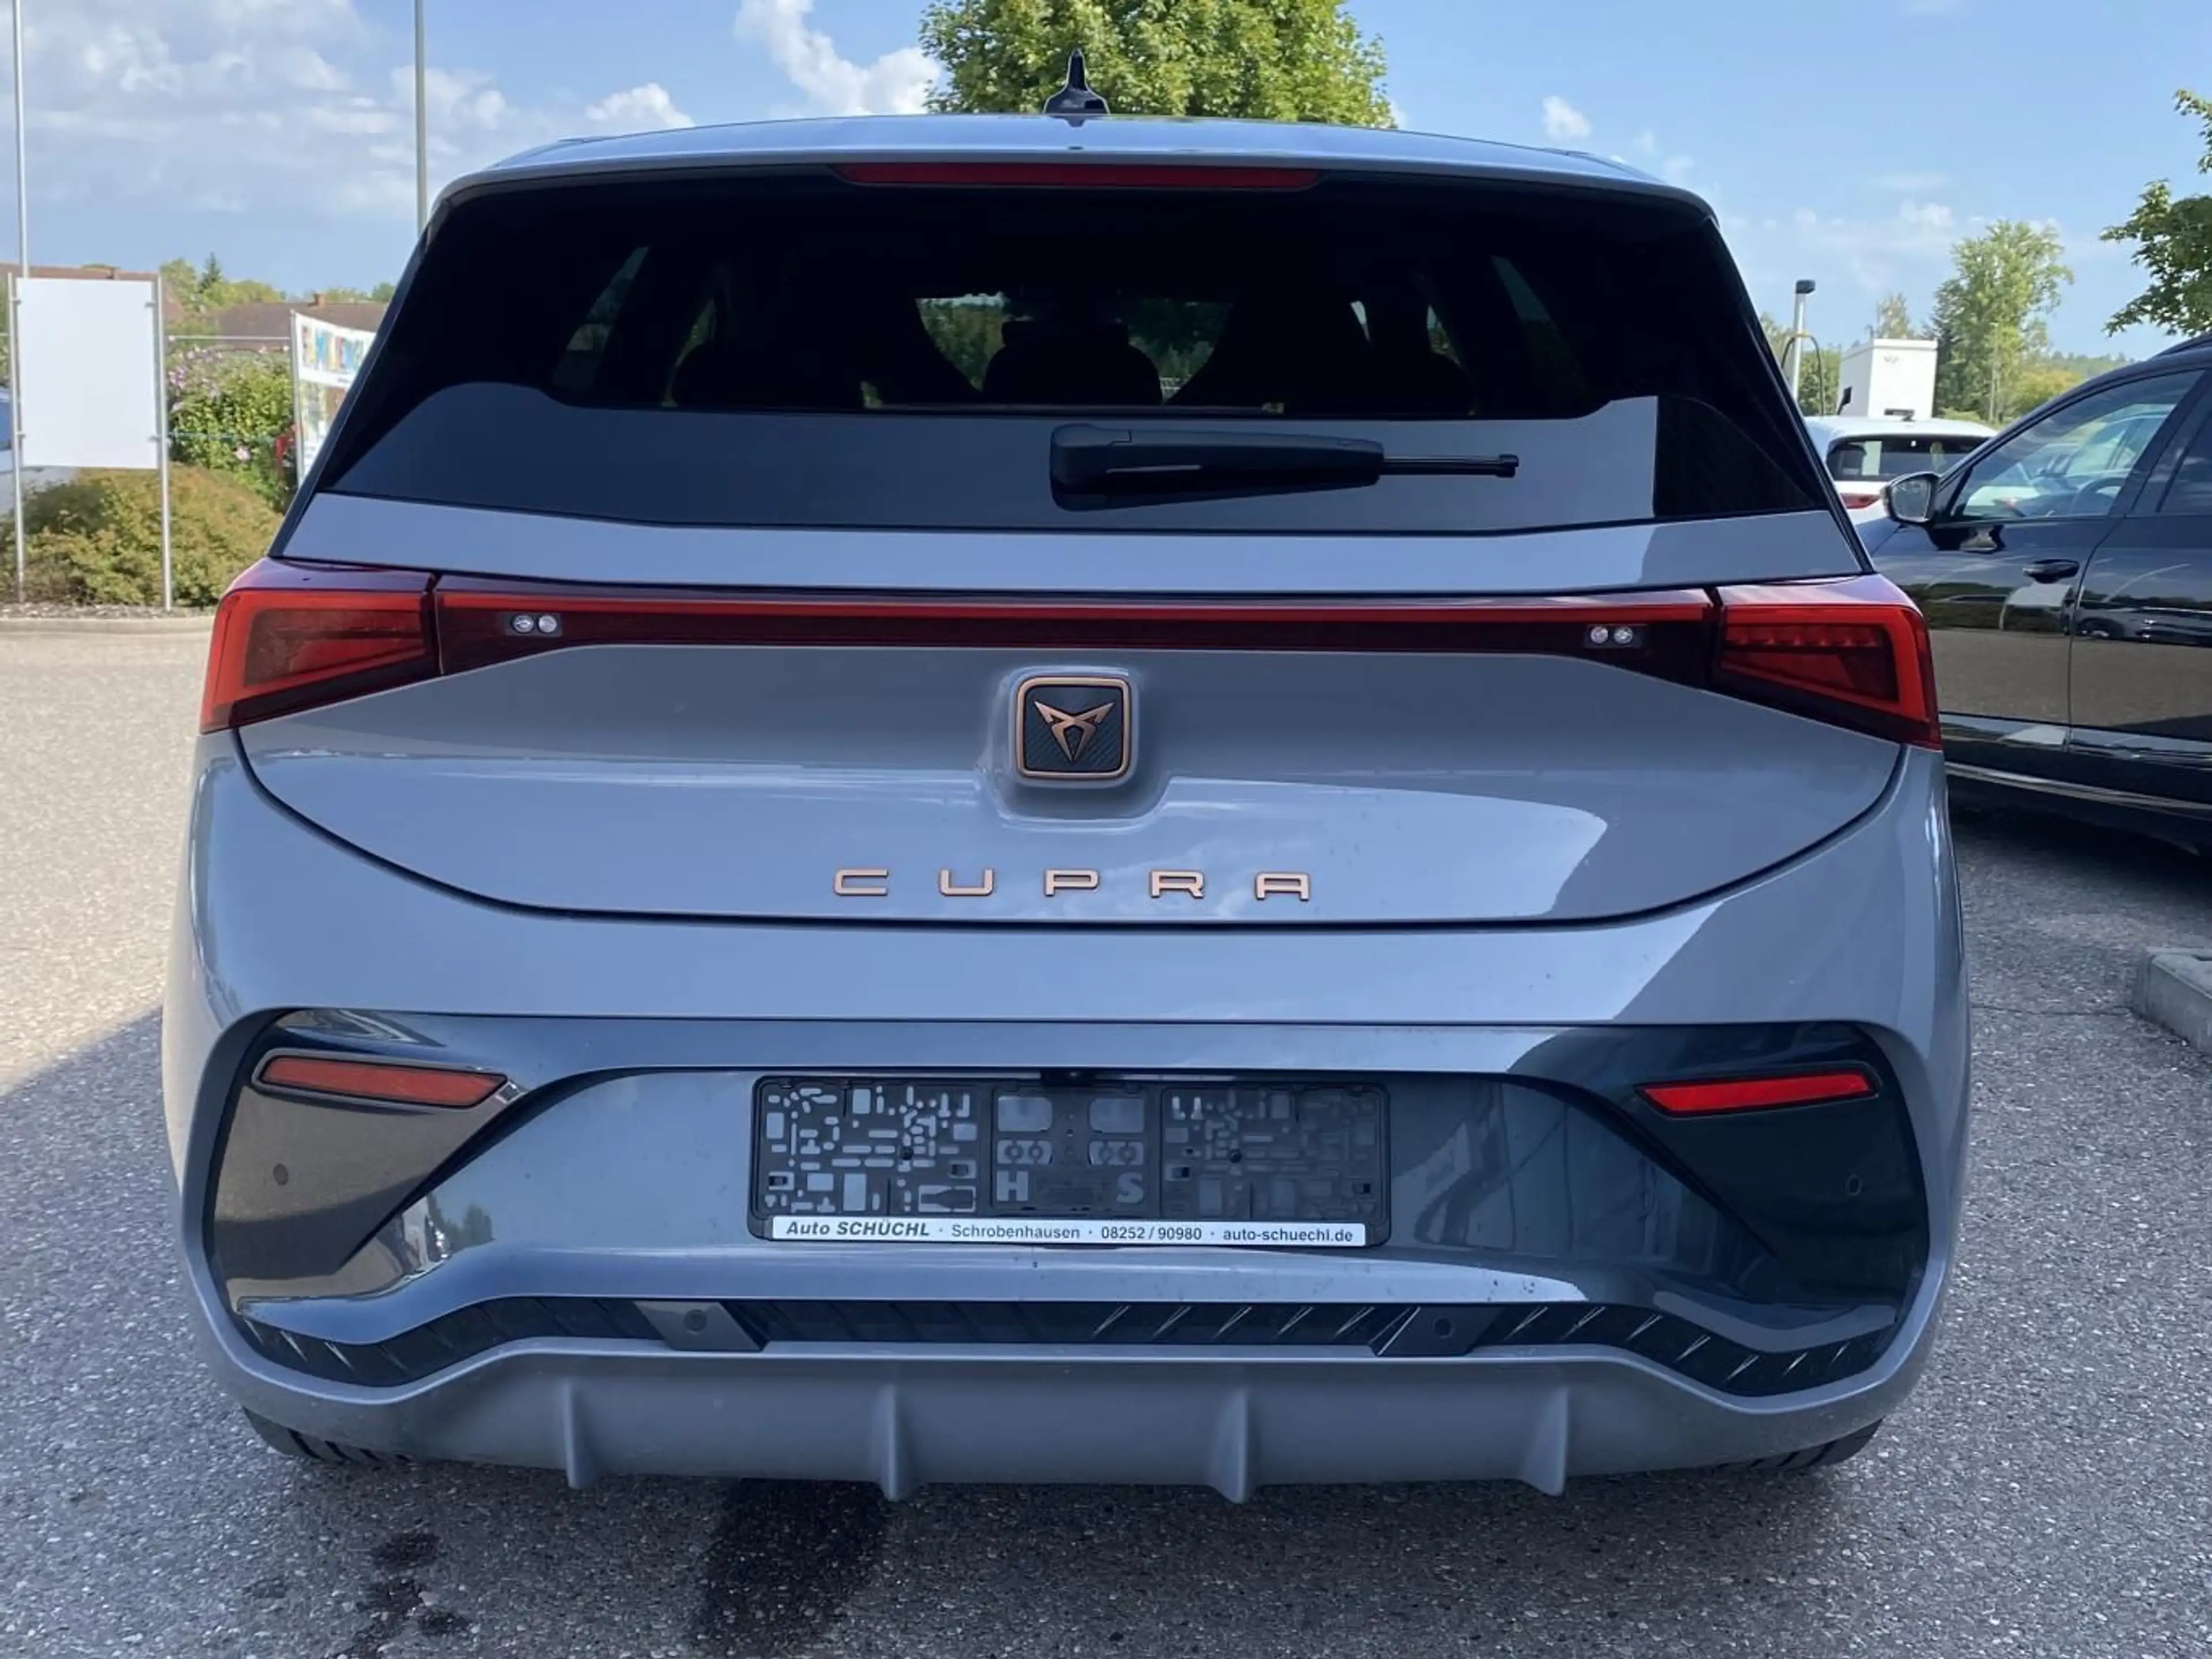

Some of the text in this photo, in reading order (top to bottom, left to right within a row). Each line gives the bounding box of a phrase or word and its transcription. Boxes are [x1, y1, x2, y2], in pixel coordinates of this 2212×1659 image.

[834, 869, 1310, 901] CUPRA
[996, 1171, 1029, 1202] H
[1116, 1172, 1144, 1203] S
[786, 1221, 830, 1235] Auto
[837, 1218, 931, 1236] SCHÜCHL
[951, 1224, 1080, 1239] Schrobenhausen
[1223, 1228, 1353, 1243] auto-schuechl.de
